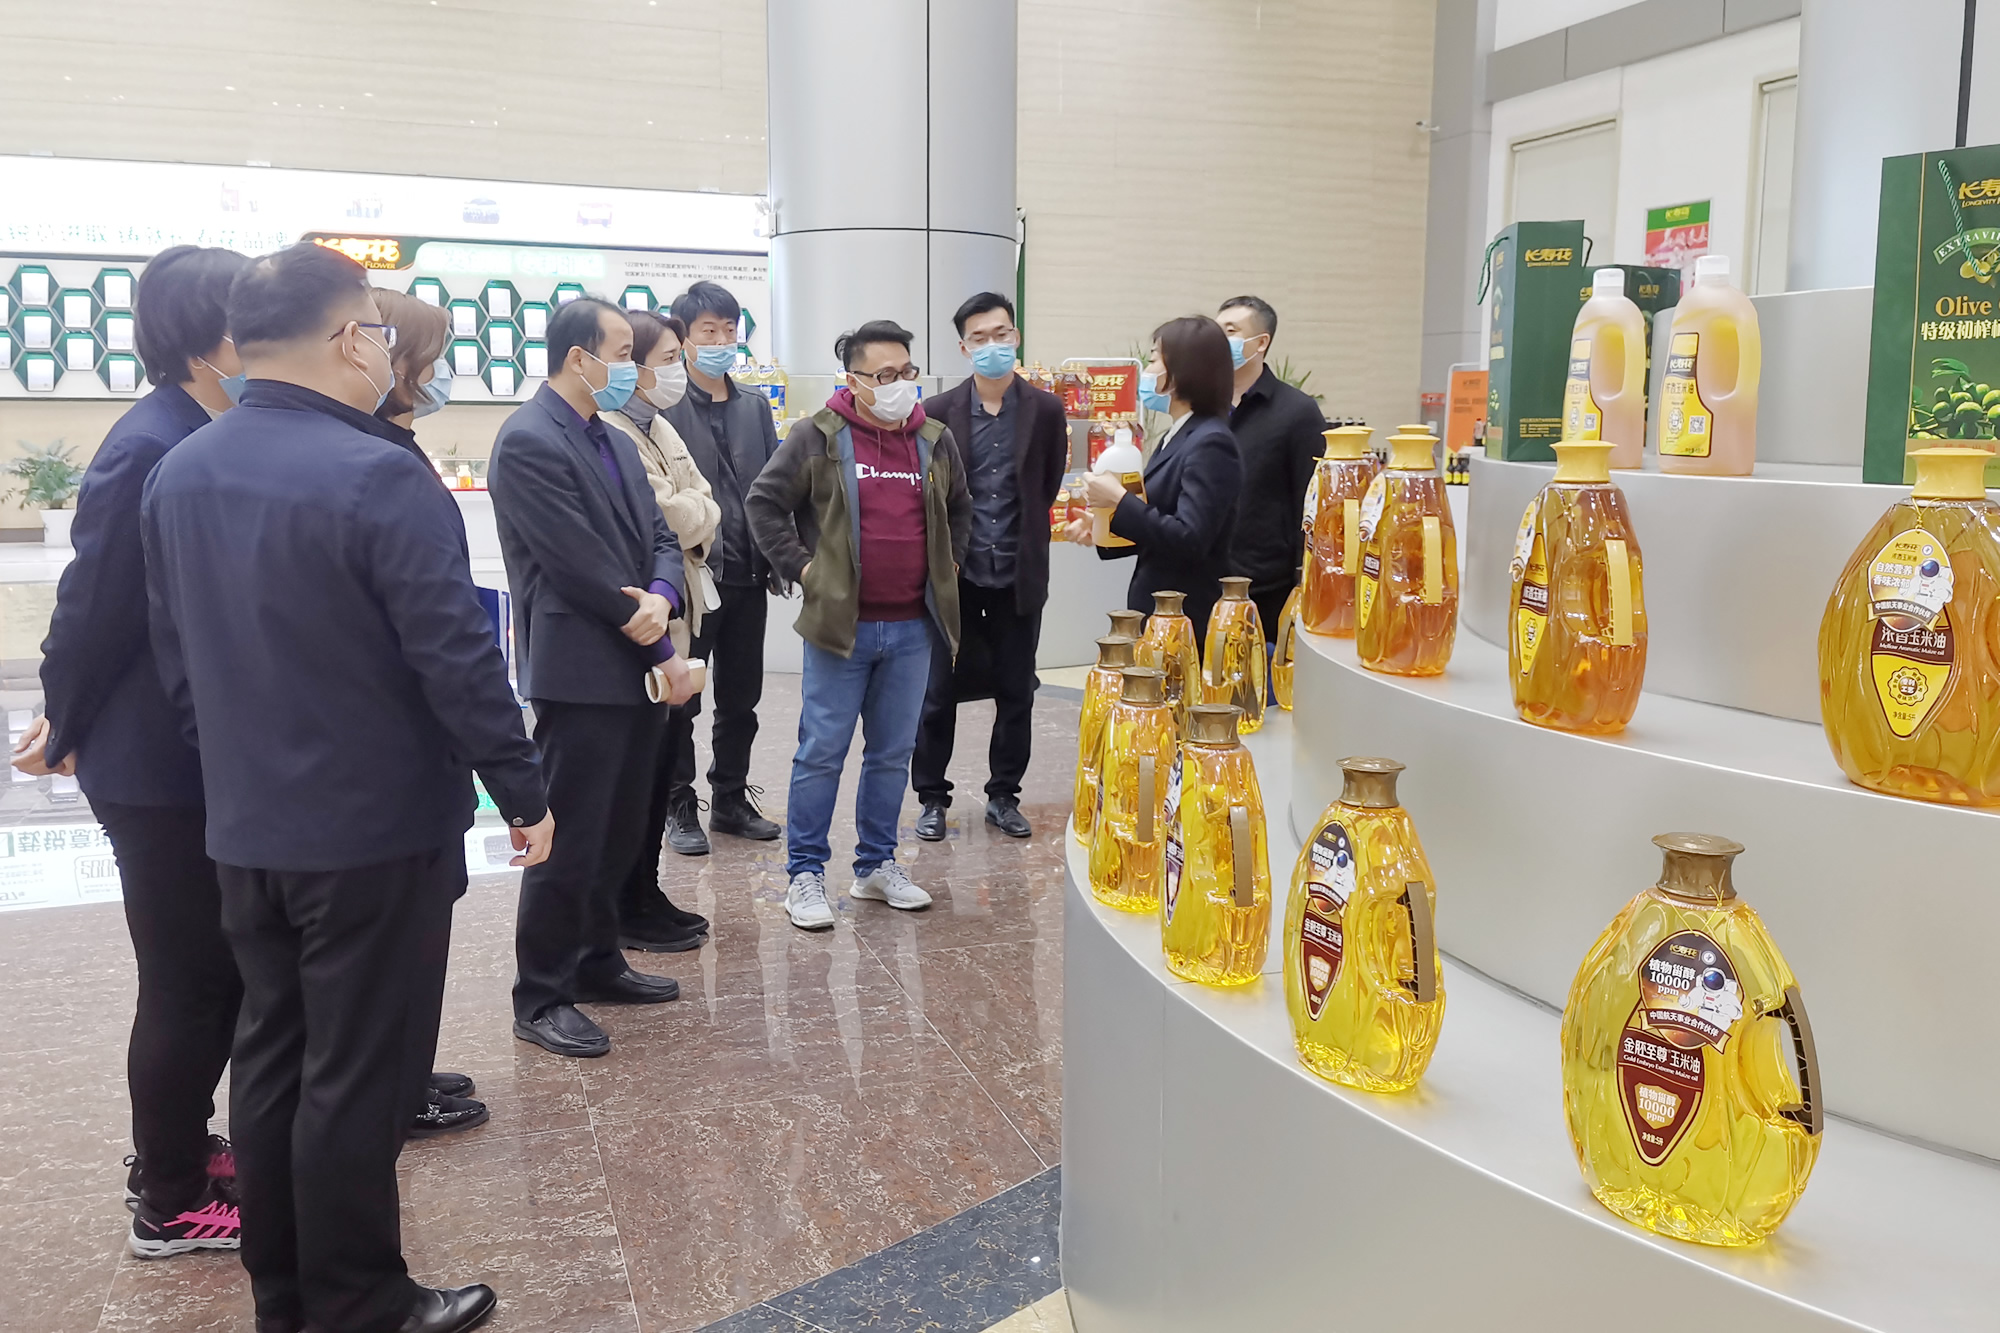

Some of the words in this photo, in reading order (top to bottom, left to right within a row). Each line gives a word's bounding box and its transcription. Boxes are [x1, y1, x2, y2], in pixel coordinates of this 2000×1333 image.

[1962, 198, 1997, 208] LONGEVITY
[365, 260, 395, 269] FLOWER
[1525, 248, 1573, 262] 长寿花
[1935, 295, 1992, 317] Olive
[855, 463, 922, 486] Champ
[1876, 562, 1913, 576] 自然营养
[1873, 575, 1910, 588] 香味浓郁
[1875, 601, 1932, 618] 中国航天事业合作伙伴
[1881, 626, 1947, 649] 浓香玉米油
[1670, 944, 1698, 957] 长寿花
[1649, 958, 1696, 980] 植物甾醇
[1650, 971, 1690, 991] 10000
[1657, 985, 1679, 996] ppm
[1649, 1010, 1719, 1036] 中国航天事业合作伙伴
[1623, 1037, 1668, 1063] 金胚至尊
[1669, 1050, 1700, 1074] 玉米油
[1623, 1054, 1637, 1063] Gold
[1637, 1057, 1655, 1069] Embryo
[1655, 1063, 1675, 1075] Extreme
[1675, 1069, 1692, 1079] Maize
[1639, 1086, 1677, 1107] 植物甾醇
[1638, 1098, 1675, 1119] 10000
[1646, 1111, 1666, 1123] ppm
